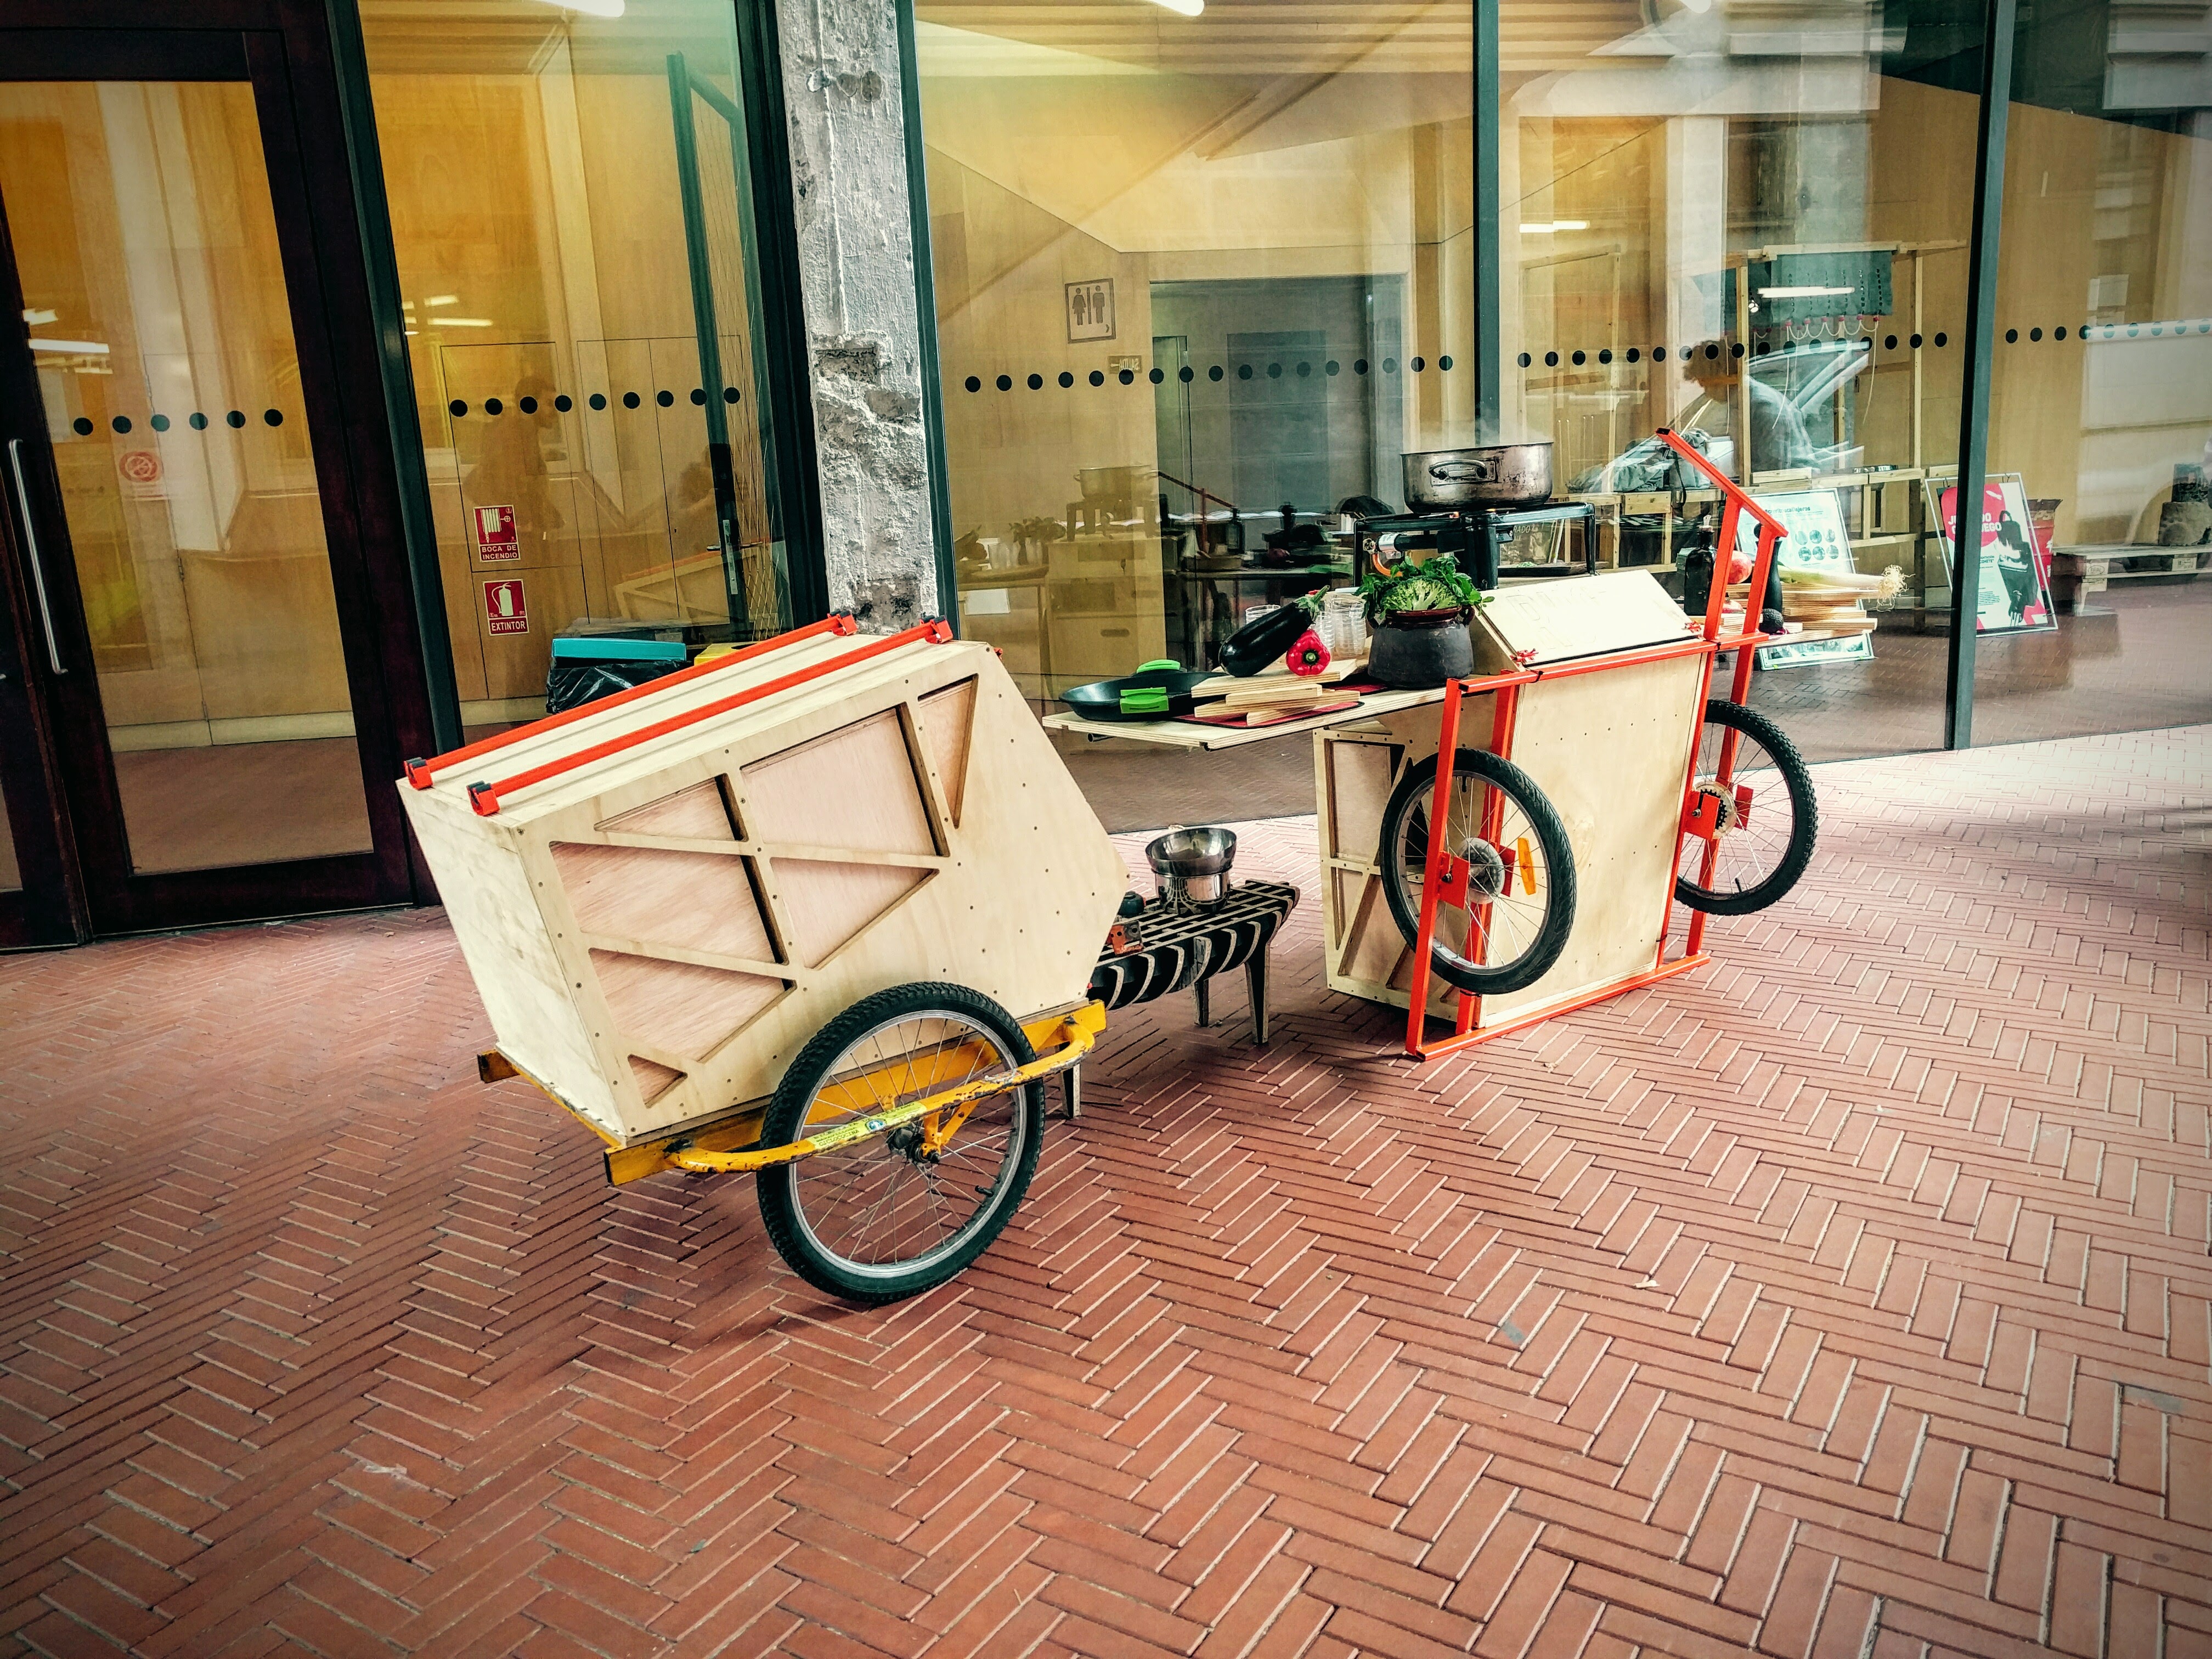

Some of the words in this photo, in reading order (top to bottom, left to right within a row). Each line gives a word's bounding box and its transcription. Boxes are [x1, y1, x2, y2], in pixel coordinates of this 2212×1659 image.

[1513, 525, 1531, 533] RADO
[483, 552, 517, 560] INCENDIO
[491, 620, 526, 631] EXTINTOR
